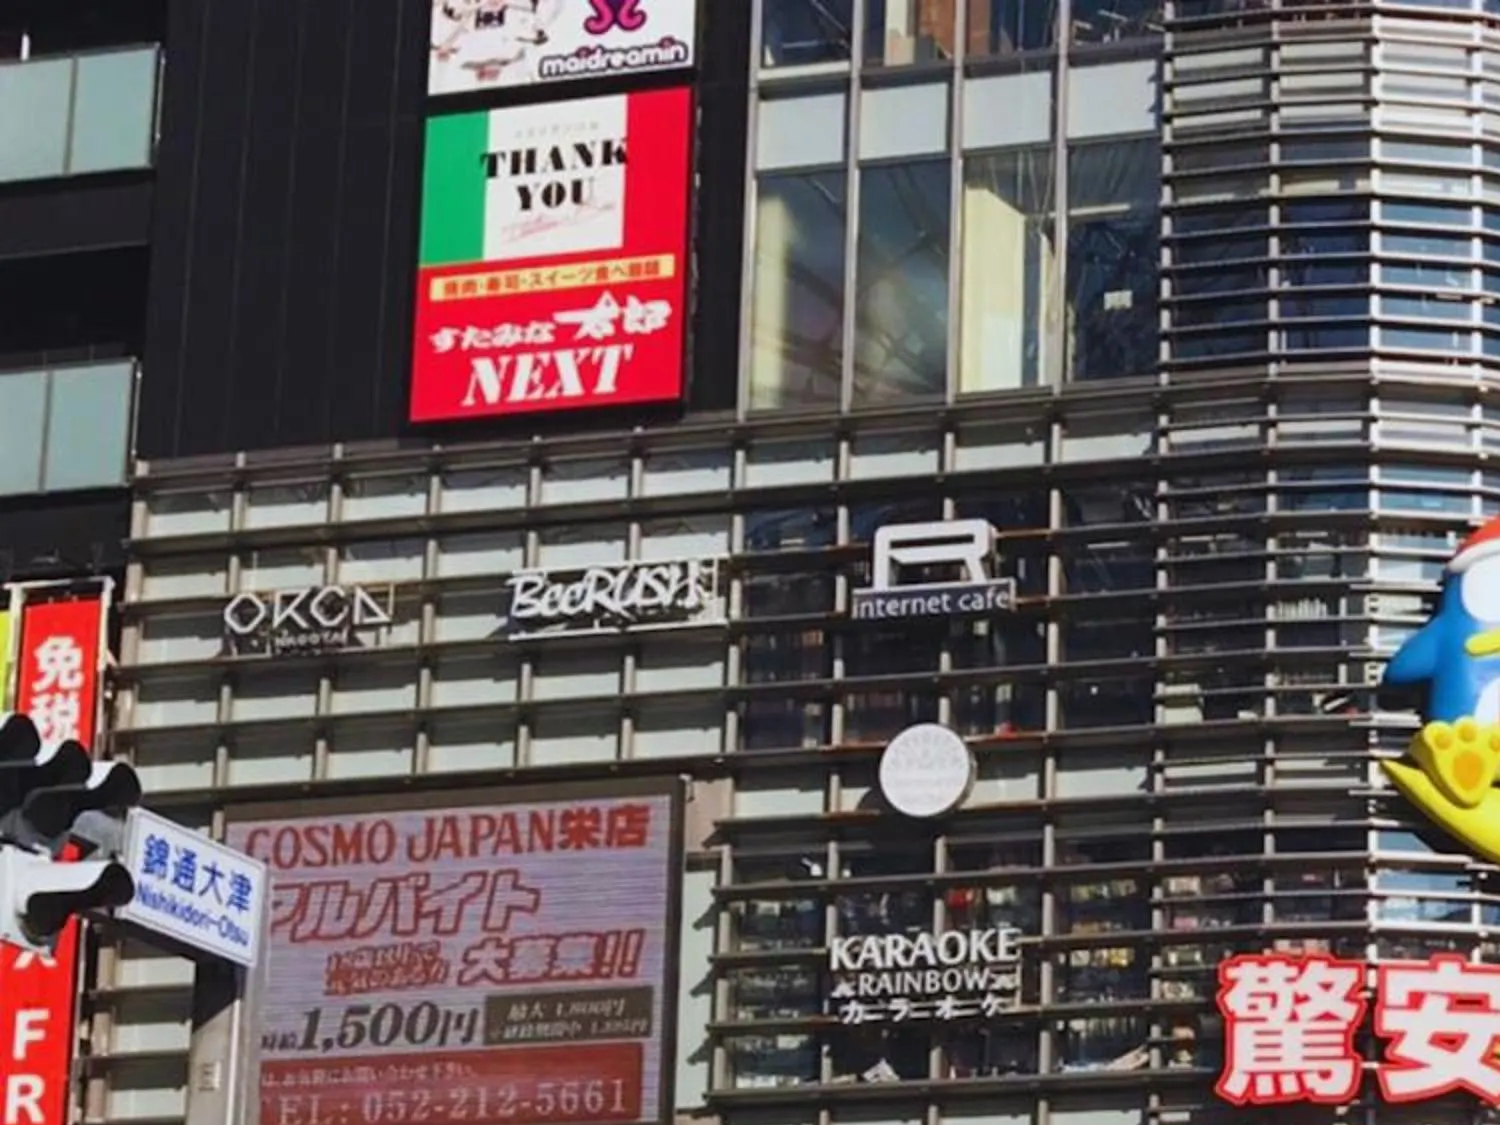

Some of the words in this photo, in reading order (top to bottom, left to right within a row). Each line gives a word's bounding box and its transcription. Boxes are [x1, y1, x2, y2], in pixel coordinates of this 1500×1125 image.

[541, 40, 687, 78] maidreamin
[480, 137, 631, 179] THANK
[517, 178, 595, 212] YOU
[461, 343, 635, 406] NEXT
[851, 590, 951, 620] internet
[958, 586, 1011, 612] cafe
[246, 819, 397, 868] COSMO
[142, 833, 252, 913] 錦通大津
[830, 928, 1022, 970] KARAOKE
[858, 966, 990, 996] RAINBOW
[361, 1078, 628, 1124] 052-212-5661
